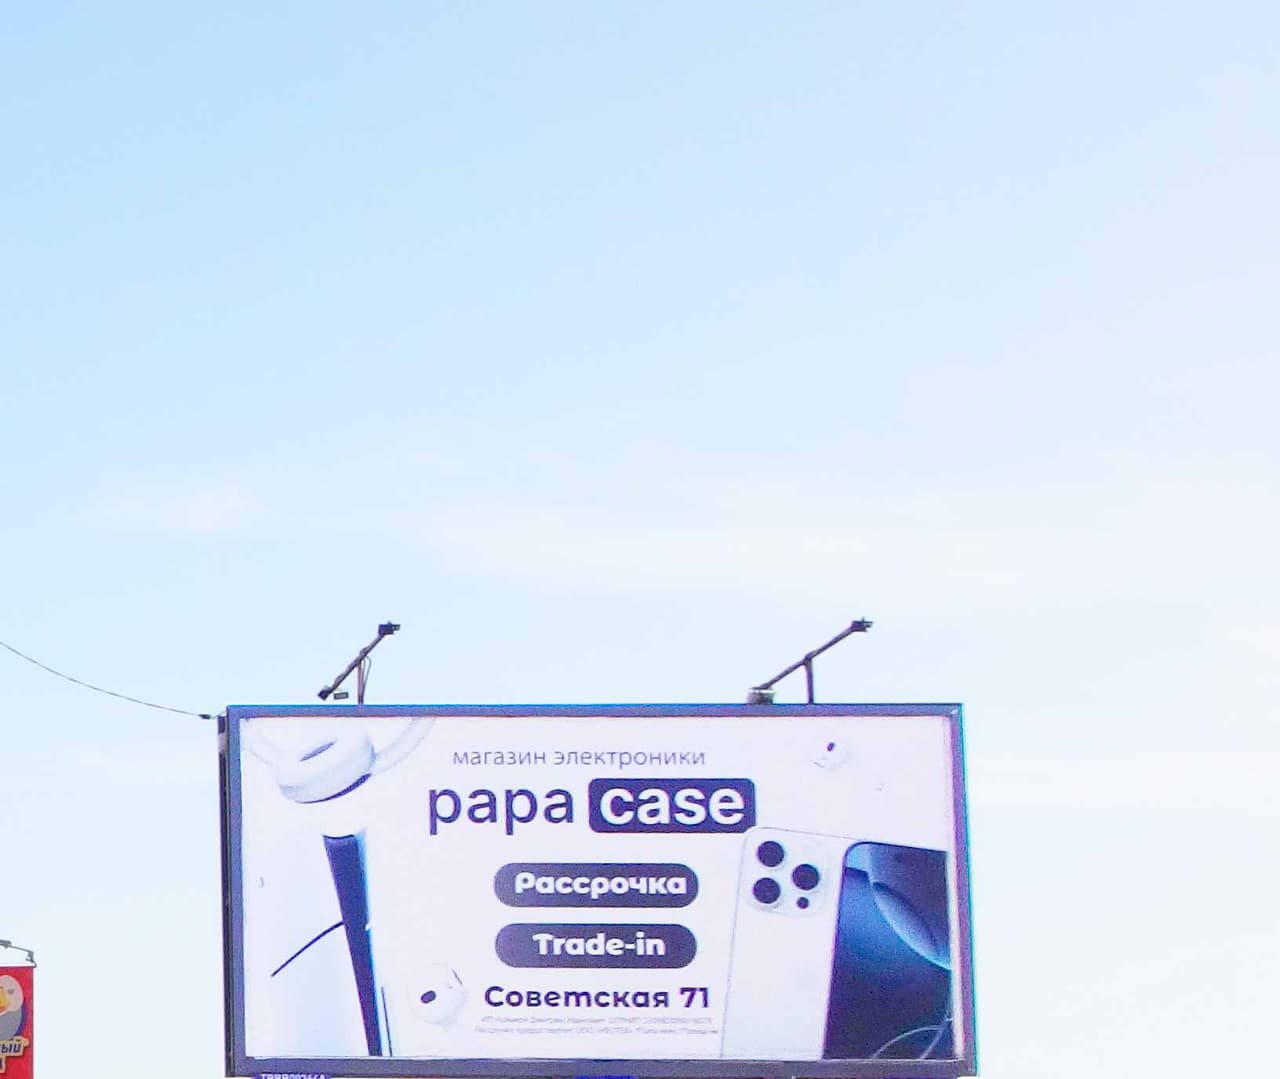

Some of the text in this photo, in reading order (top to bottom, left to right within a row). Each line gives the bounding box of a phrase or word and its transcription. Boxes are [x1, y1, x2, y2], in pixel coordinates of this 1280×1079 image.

[452, 750, 707, 769] магазин электроники
[428, 785, 746, 836] papa case
[514, 871, 688, 900] Рассрочка
[532, 931, 667, 956] Trade-in
[484, 985, 710, 1009] Советская 71
